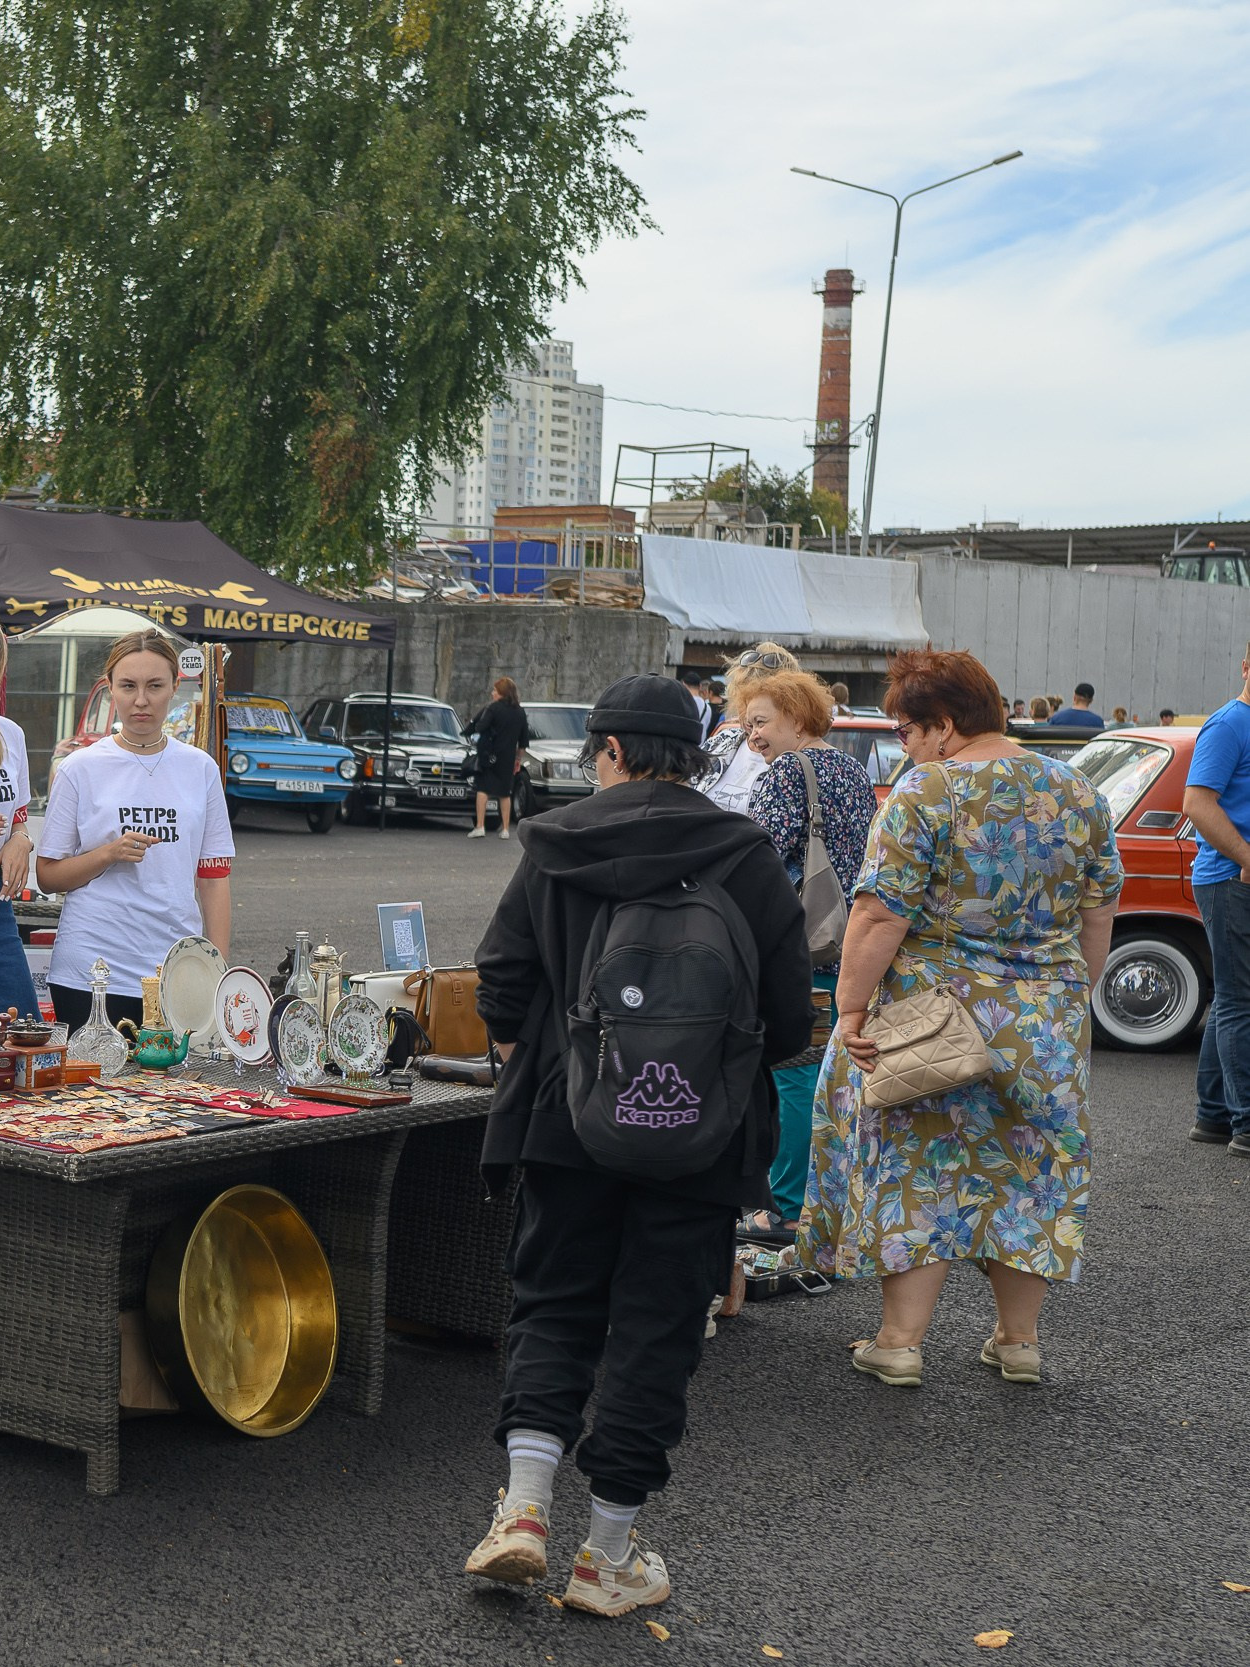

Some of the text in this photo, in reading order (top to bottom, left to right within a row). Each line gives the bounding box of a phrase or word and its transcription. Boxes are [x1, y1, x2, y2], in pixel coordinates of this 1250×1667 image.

[203, 607, 372, 641] МАСТЕРСКИЕ
[118, 807, 177, 823] РЕТРО
[616, 1105, 700, 1129] Kappa
